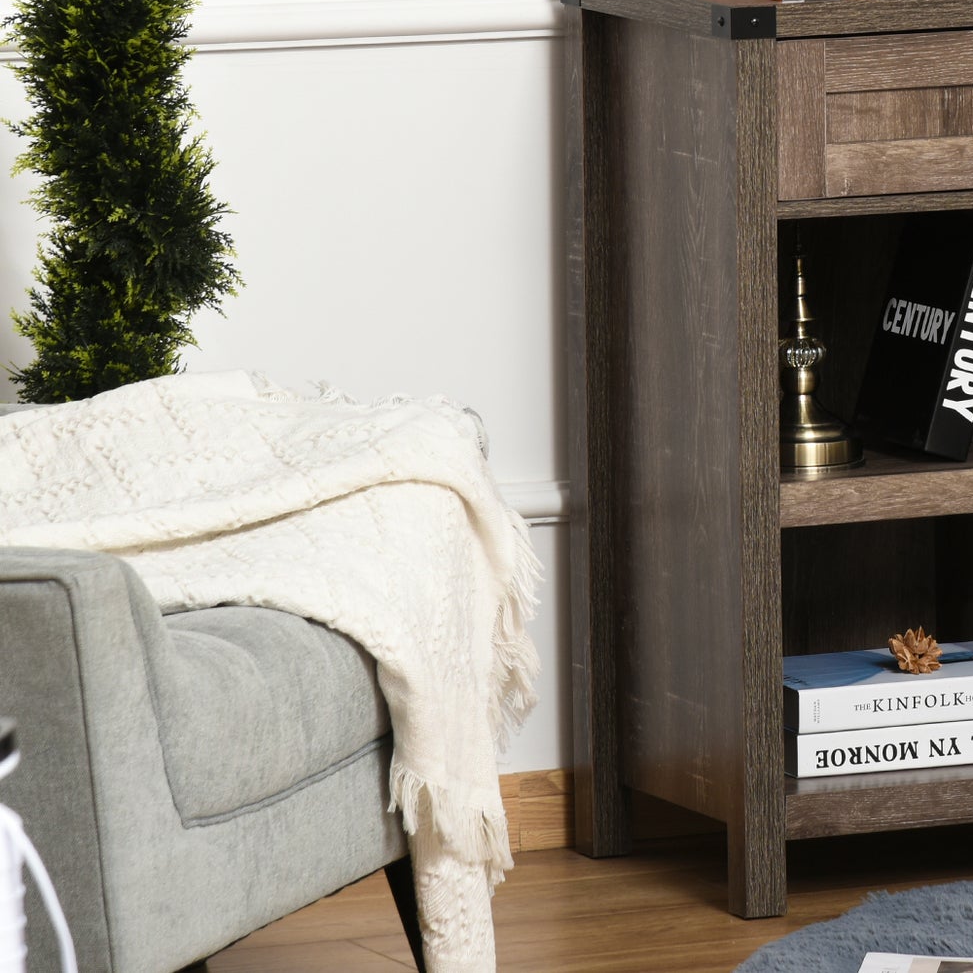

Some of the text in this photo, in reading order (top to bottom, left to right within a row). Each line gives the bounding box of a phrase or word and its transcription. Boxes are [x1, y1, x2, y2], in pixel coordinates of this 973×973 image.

[882, 297, 956, 345] CENTURY
[854, 703, 871, 711] THE
[872, 691, 965, 713] KINFOLK
[815, 741, 919, 769] MONROE
[928, 737, 962, 758] YN
